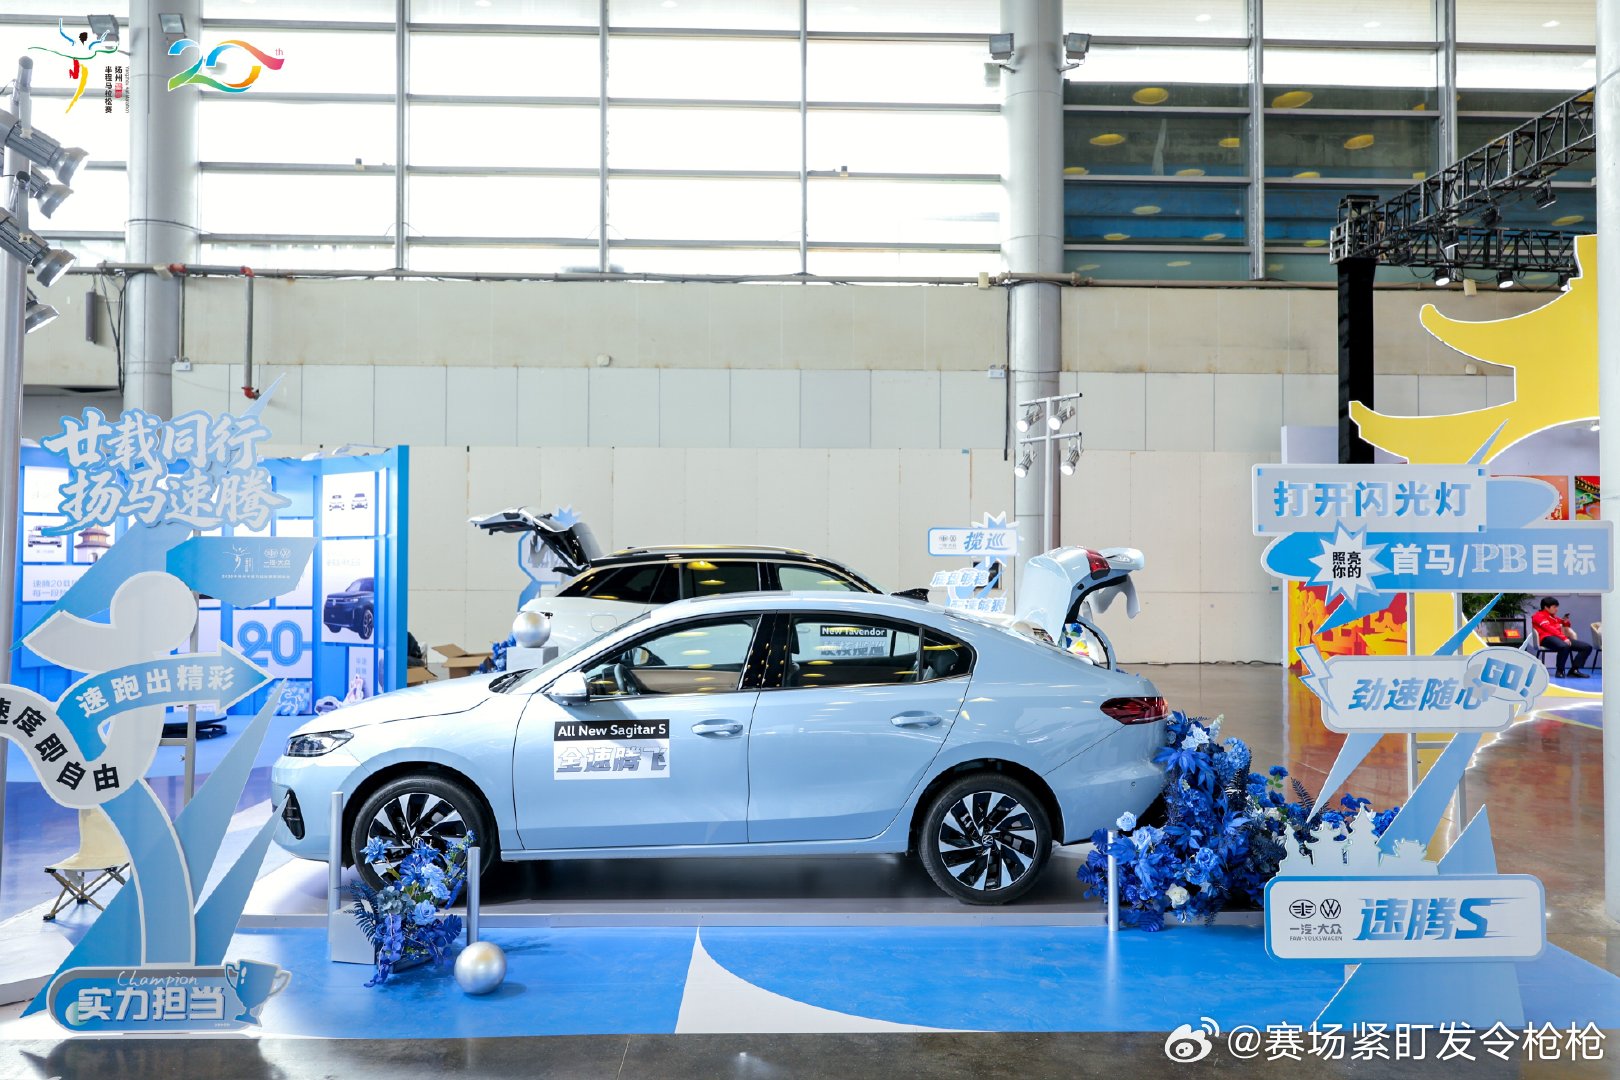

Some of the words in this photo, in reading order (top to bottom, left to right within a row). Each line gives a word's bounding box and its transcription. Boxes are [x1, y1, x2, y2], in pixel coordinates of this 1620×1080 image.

[44, 411, 269, 474] 廿载同行
[60, 468, 287, 532] 扬马速腾
[1273, 480, 1472, 518] 打开闪光灯
[964, 531, 1009, 552] 揽巡
[1332, 551, 1362, 565] 照亮
[1332, 565, 1362, 579] 你的
[1390, 543, 1596, 578] 首马/PB目标
[75, 664, 236, 718] 速跑出精彩
[1348, 677, 1490, 712] 劲速随心
[1481, 657, 1535, 697] GO!
[557, 725, 576, 737] All
[578, 725, 608, 736] New
[610, 724, 656, 738] Sagitar
[658, 723, 667, 735] S
[556, 746, 669, 773] 全速腾飞
[1352, 897, 1497, 941] 速腾S
[117, 970, 200, 988] Champion
[78, 986, 226, 1021] 实力担当
